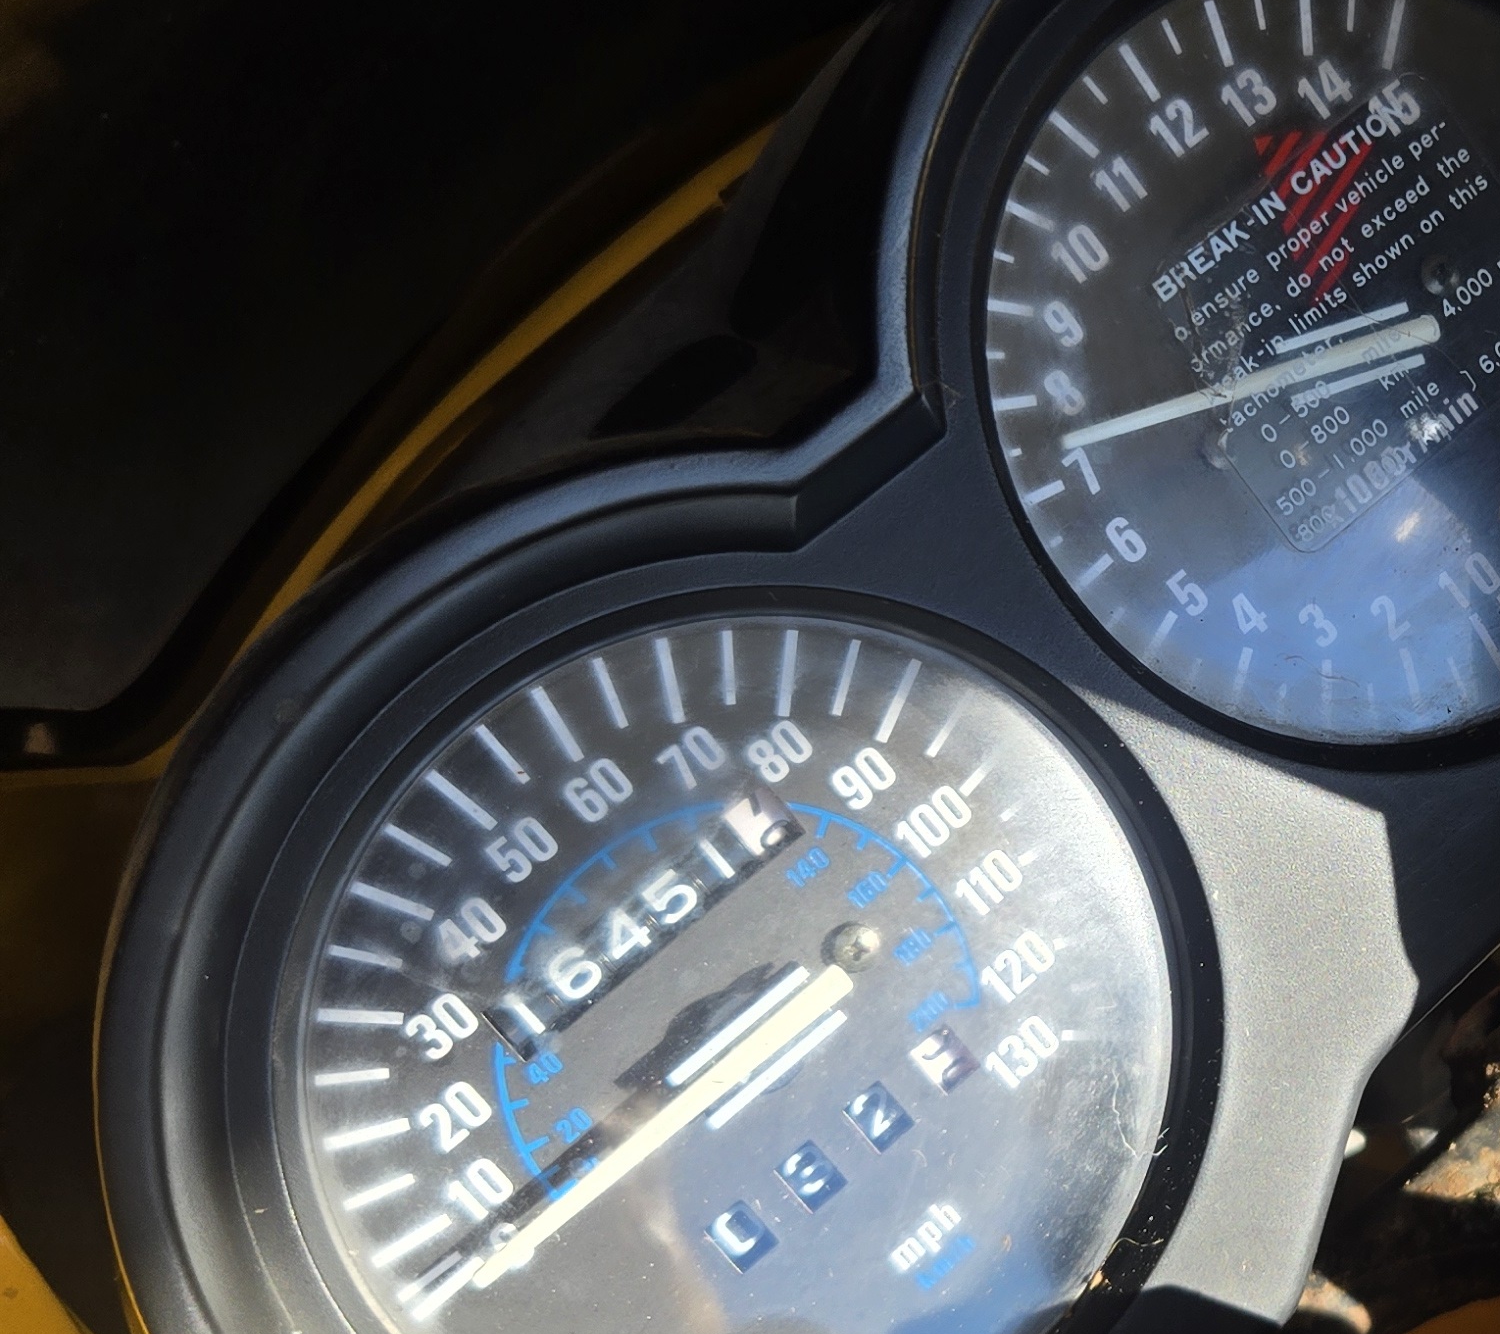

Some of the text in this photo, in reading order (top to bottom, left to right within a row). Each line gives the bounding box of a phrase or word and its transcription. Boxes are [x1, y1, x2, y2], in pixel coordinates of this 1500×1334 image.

[1221, 69, 1277, 127] 13
[1298, 59, 1353, 120] 14
[1368, 78, 1421, 137] 15
[1150, 99, 1209, 158] 12
[1094, 156, 1148, 212] 11
[1152, 97, 1407, 303] BREAK-IN CAUTION
[1191, 269, 1259, 327] ensure
[1266, 212, 1330, 271] proper
[1335, 154, 1405, 214] vehicle
[1408, 121, 1447, 161] per-
[1288, 287, 1348, 335] limits
[1352, 233, 1415, 288] shown
[1420, 208, 1446, 234] on
[1448, 172, 1489, 211] this
[1051, 225, 1110, 284] 10
[1190, 146, 1471, 374] ormance, do not exceed the
[1044, 300, 1084, 348] 9
[1361, 329, 1402, 365] mile
[1044, 369, 1087, 416] 8
[1400, 379, 1440, 420] mile
[1061, 446, 1101, 496] 7
[1105, 517, 1147, 563] 6
[1166, 568, 1209, 617] 5
[1438, 570, 1470, 609] 1
[1465, 552, 1500, 595] 0
[1231, 592, 1269, 635] 4
[1298, 603, 1338, 648] 3
[1369, 595, 1412, 642] 2
[656, 725, 727, 790] 70
[747, 720, 813, 783] 80
[831, 747, 897, 810] 90
[563, 757, 634, 823] 60
[484, 815, 559, 883] 50
[896, 785, 972, 859] 100
[955, 849, 1023, 917] 110
[435, 896, 507, 963] 40
[981, 930, 1056, 1005] 120
[405, 992, 479, 1060] 30
[985, 1015, 1060, 1090] 130
[525, 1050, 565, 1086] 40
[419, 1080, 492, 1154] 20
[555, 1106, 595, 1145] 20
[448, 1157, 514, 1221] 10
[889, 1201, 963, 1272] mph
